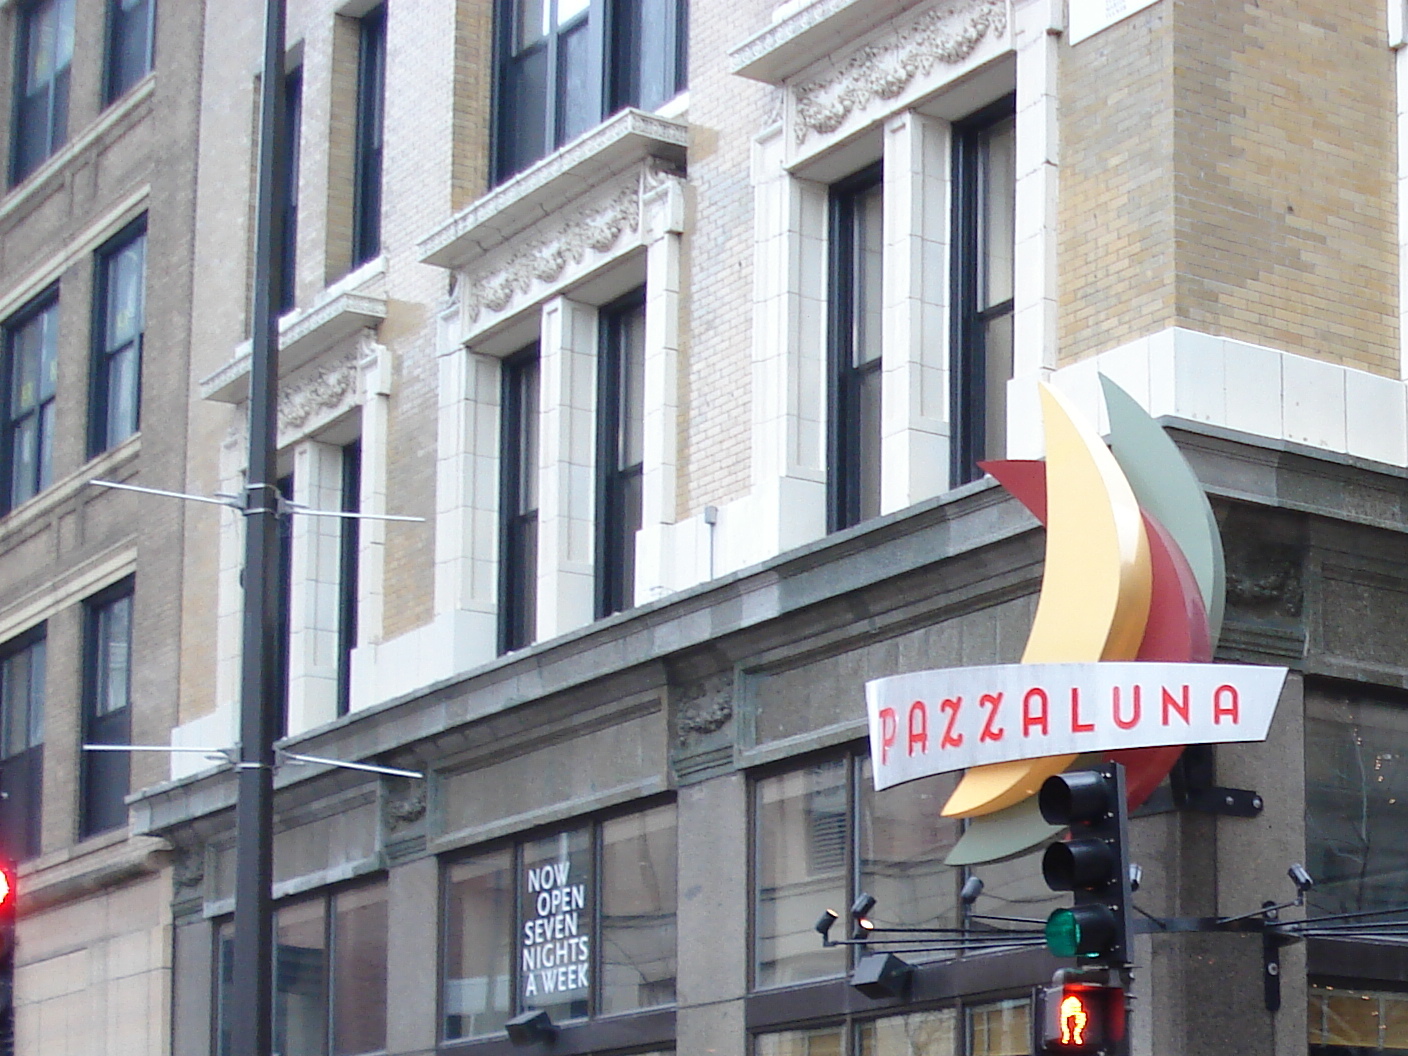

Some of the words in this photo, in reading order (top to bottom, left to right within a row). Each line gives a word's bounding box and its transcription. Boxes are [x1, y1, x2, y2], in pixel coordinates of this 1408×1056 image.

[878, 684, 1241, 766] PAZZALUNA
[528, 862, 570, 893] NOW
[536, 884, 585, 917] OPEN
[524, 913, 578, 945] SEVEN
[522, 936, 589, 972] NIGHTS
[525, 972, 538, 997] A
[541, 963, 589, 993] WEEK
